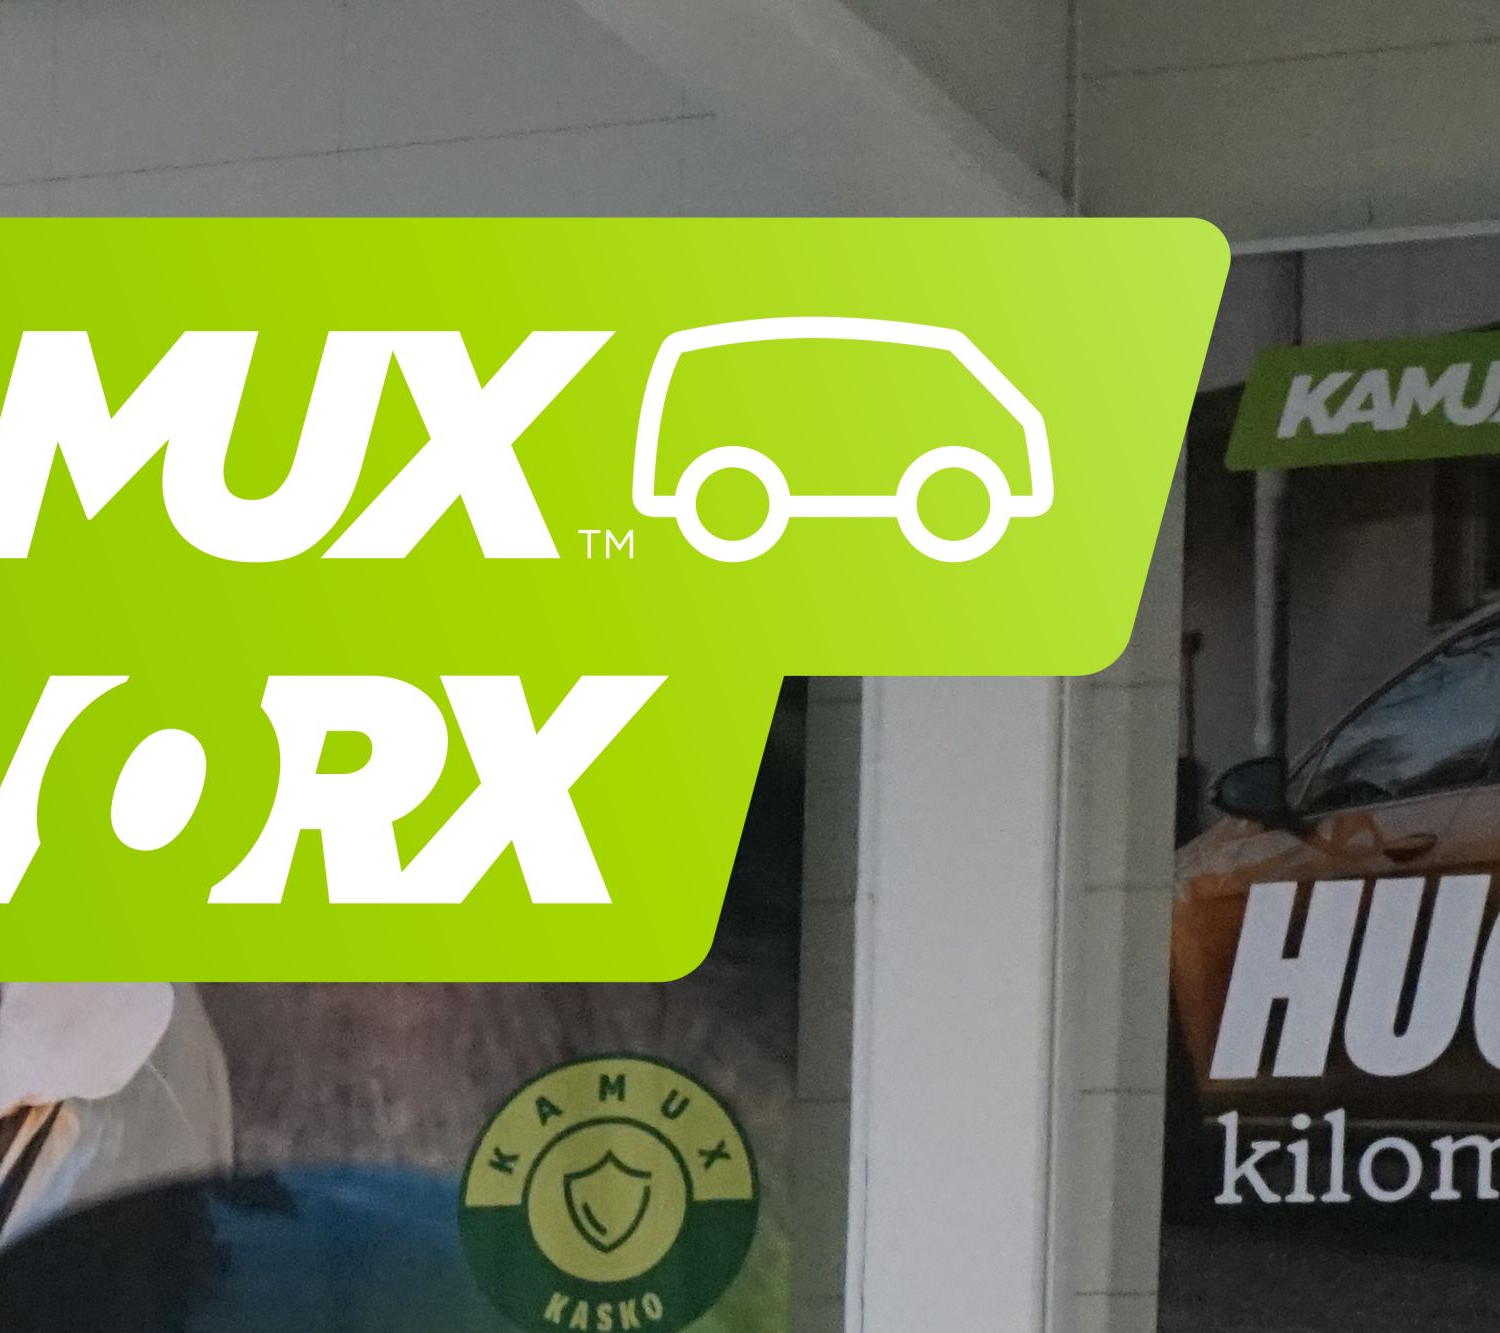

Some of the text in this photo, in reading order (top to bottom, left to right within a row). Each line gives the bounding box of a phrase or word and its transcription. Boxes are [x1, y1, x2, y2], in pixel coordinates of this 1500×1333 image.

[1277, 361, 1500, 440] KAMU
[1209, 874, 1500, 1080] HU
[487, 1073, 731, 1174] KAMUX
[543, 1292, 664, 1333] KASKO
